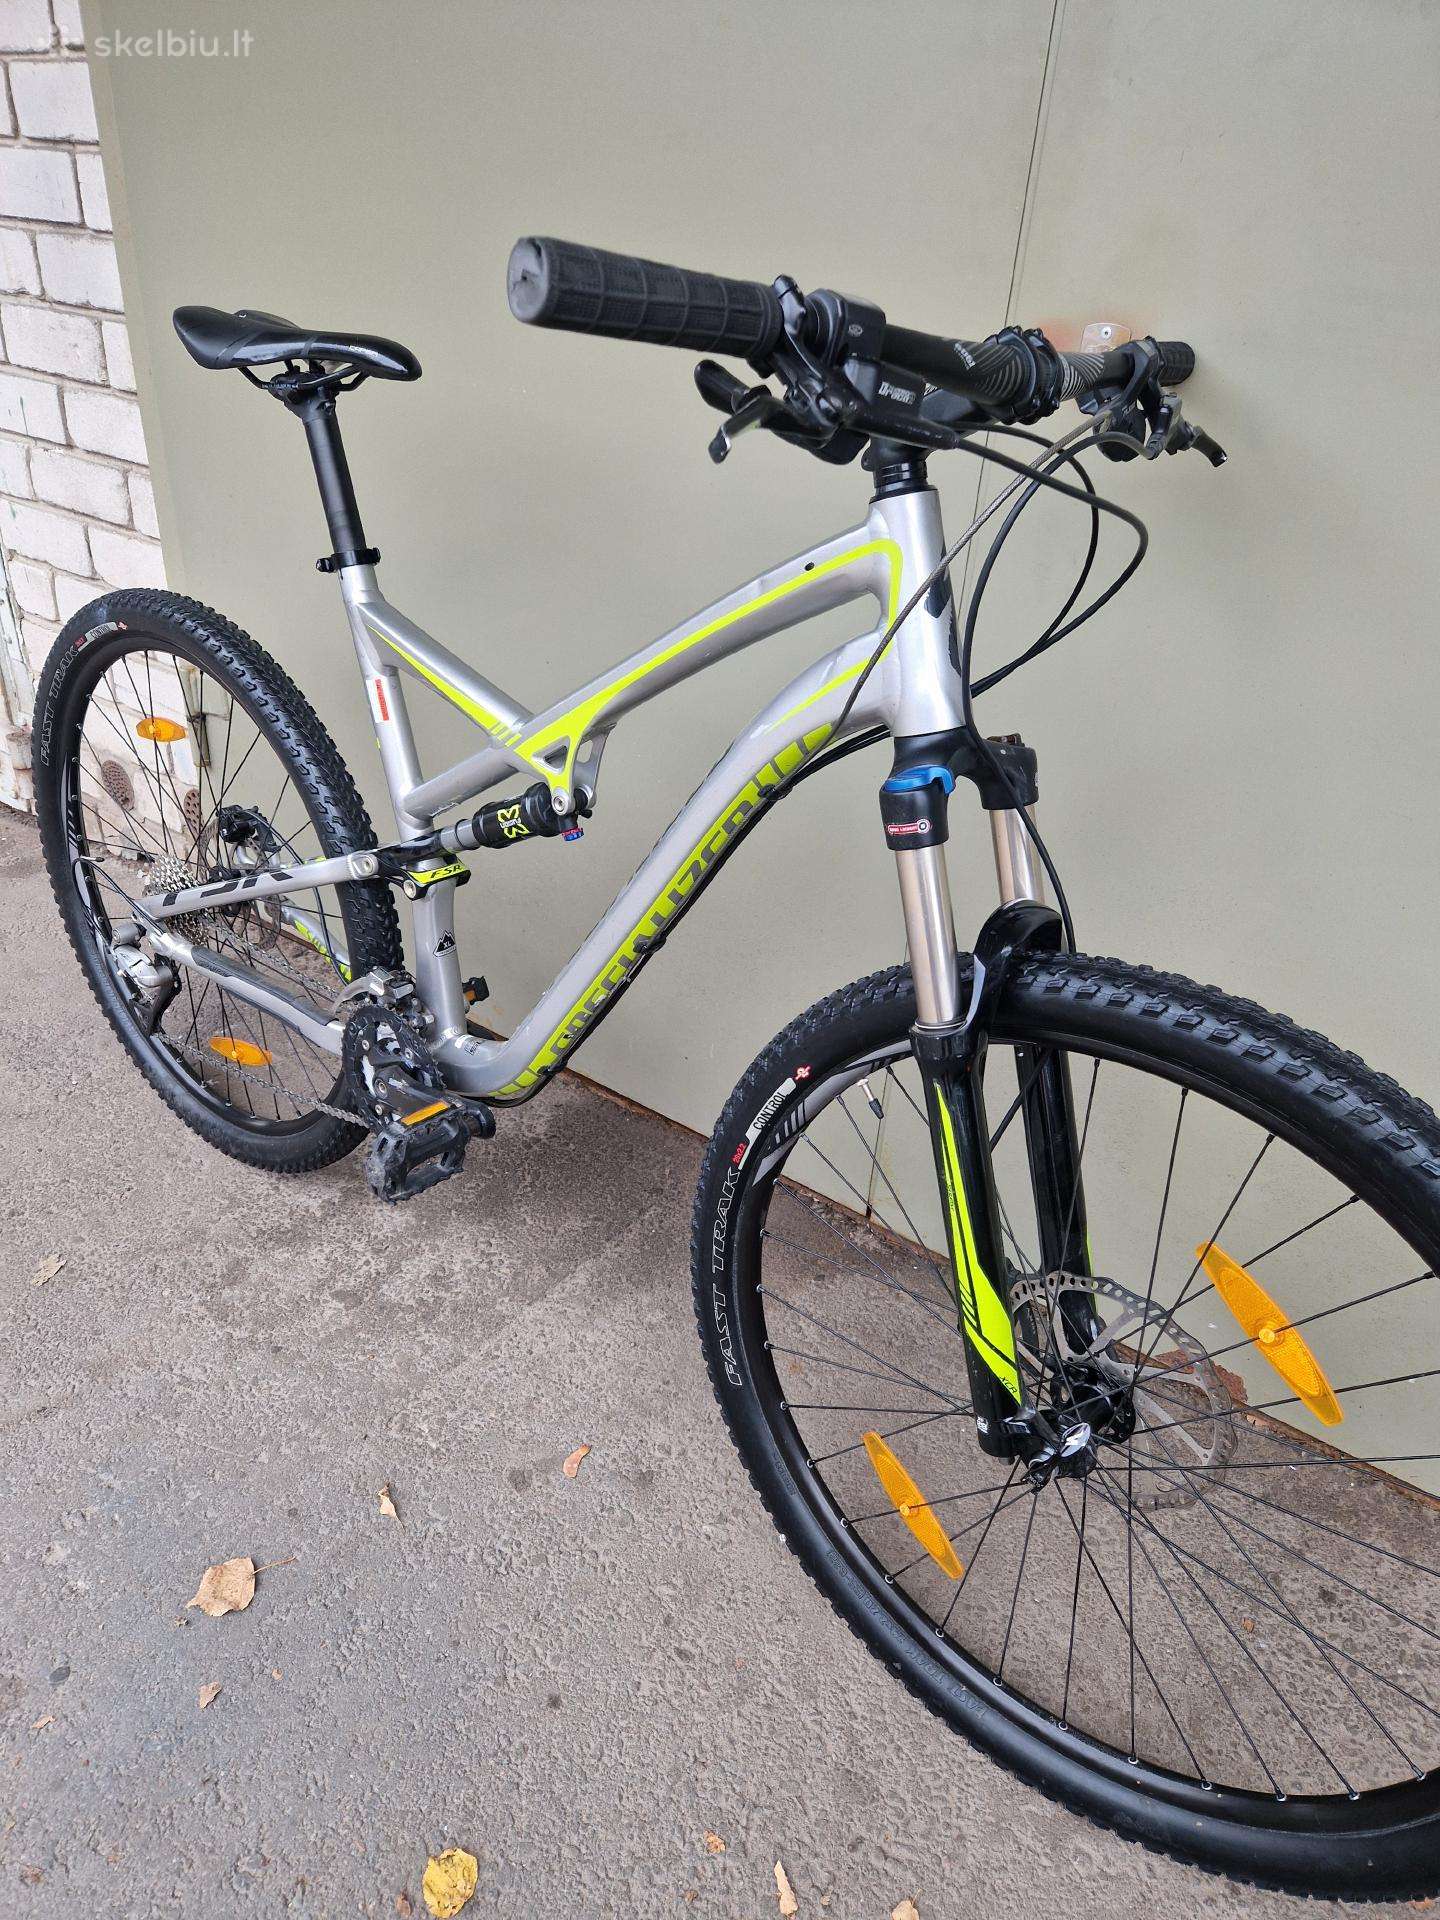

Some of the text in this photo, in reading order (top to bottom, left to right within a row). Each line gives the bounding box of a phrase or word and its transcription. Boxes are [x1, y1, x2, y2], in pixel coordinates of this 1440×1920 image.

[40, 645, 79, 767] FAST TRAK
[430, 864, 462, 879] FSR
[443, 941, 452, 949] XL
[752, 1092, 787, 1130] CONTROL
[713, 1167, 743, 1386] FAST TRAK
[1000, 1376, 1017, 1394] XCR
